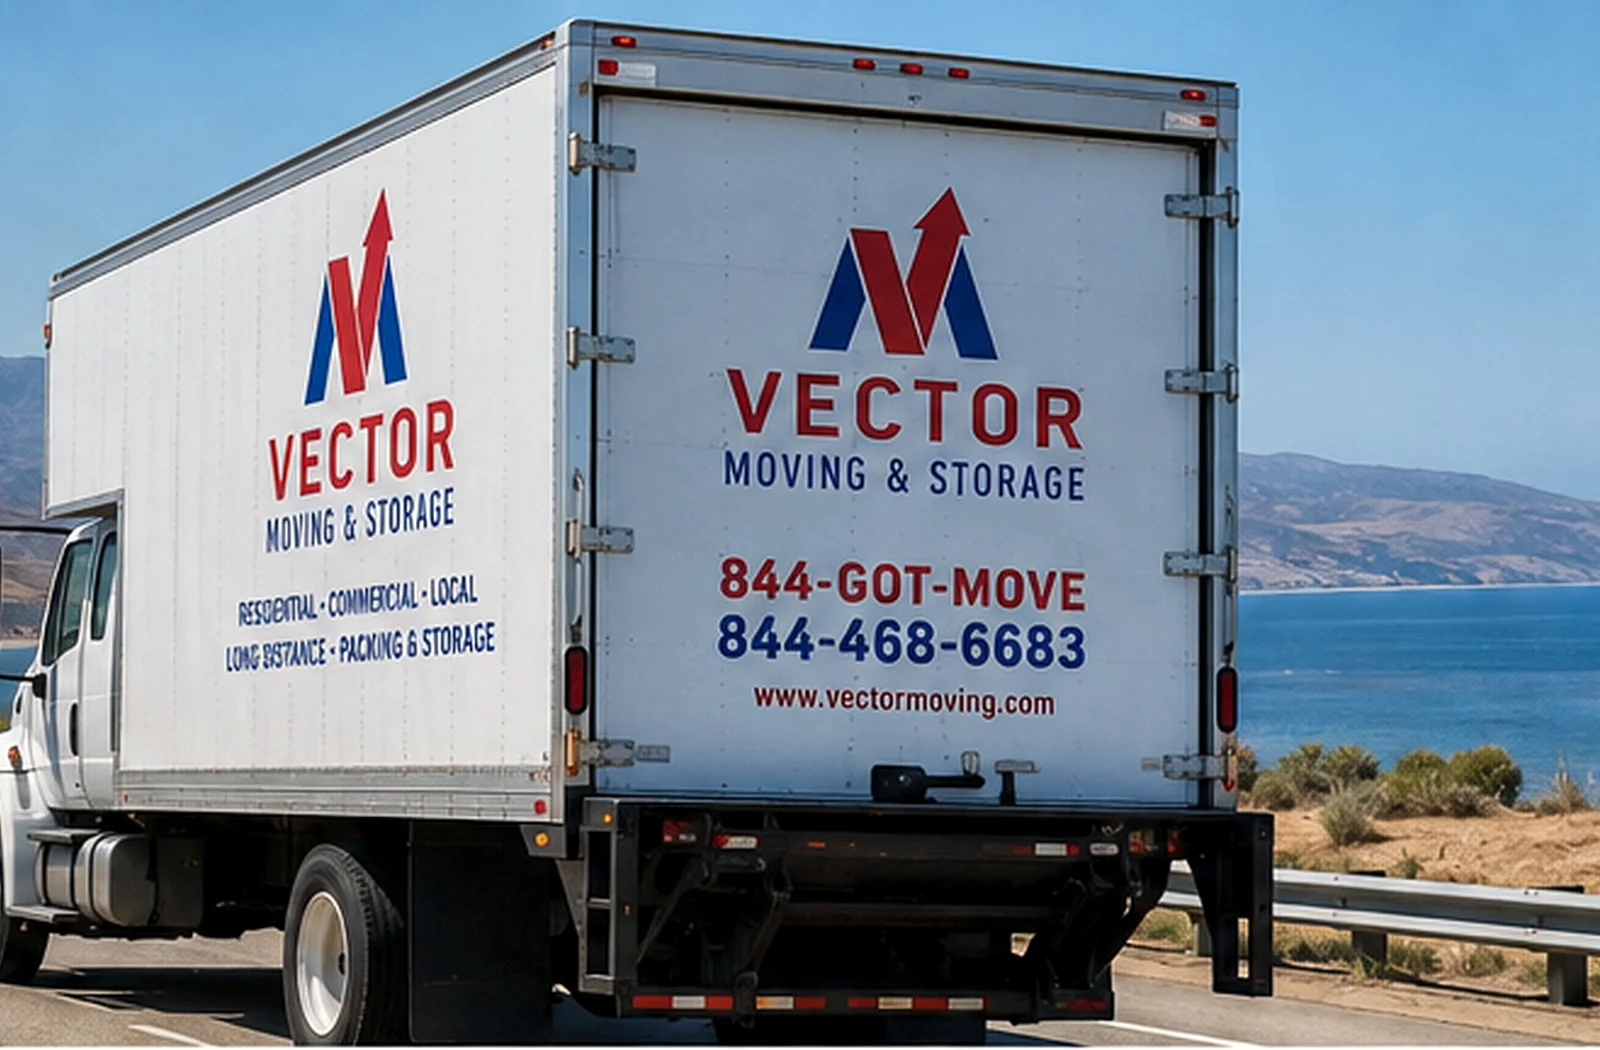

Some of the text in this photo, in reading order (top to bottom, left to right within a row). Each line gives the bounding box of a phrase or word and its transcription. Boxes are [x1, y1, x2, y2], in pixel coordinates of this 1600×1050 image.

[727, 369, 1082, 450] VECTOR
[268, 399, 454, 501] VECTOR
[724, 450, 1085, 501] MOVING & STORAGE
[266, 486, 454, 553] MOVING & STORAGE
[430, 575, 478, 607] LOCAL
[720, 557, 1085, 612] 844-GOT-MOVE
[422, 622, 496, 657] STORAGE
[718, 614, 1086, 670] 844-468-6683
[753, 686, 1055, 721] www.vectormoving.com
